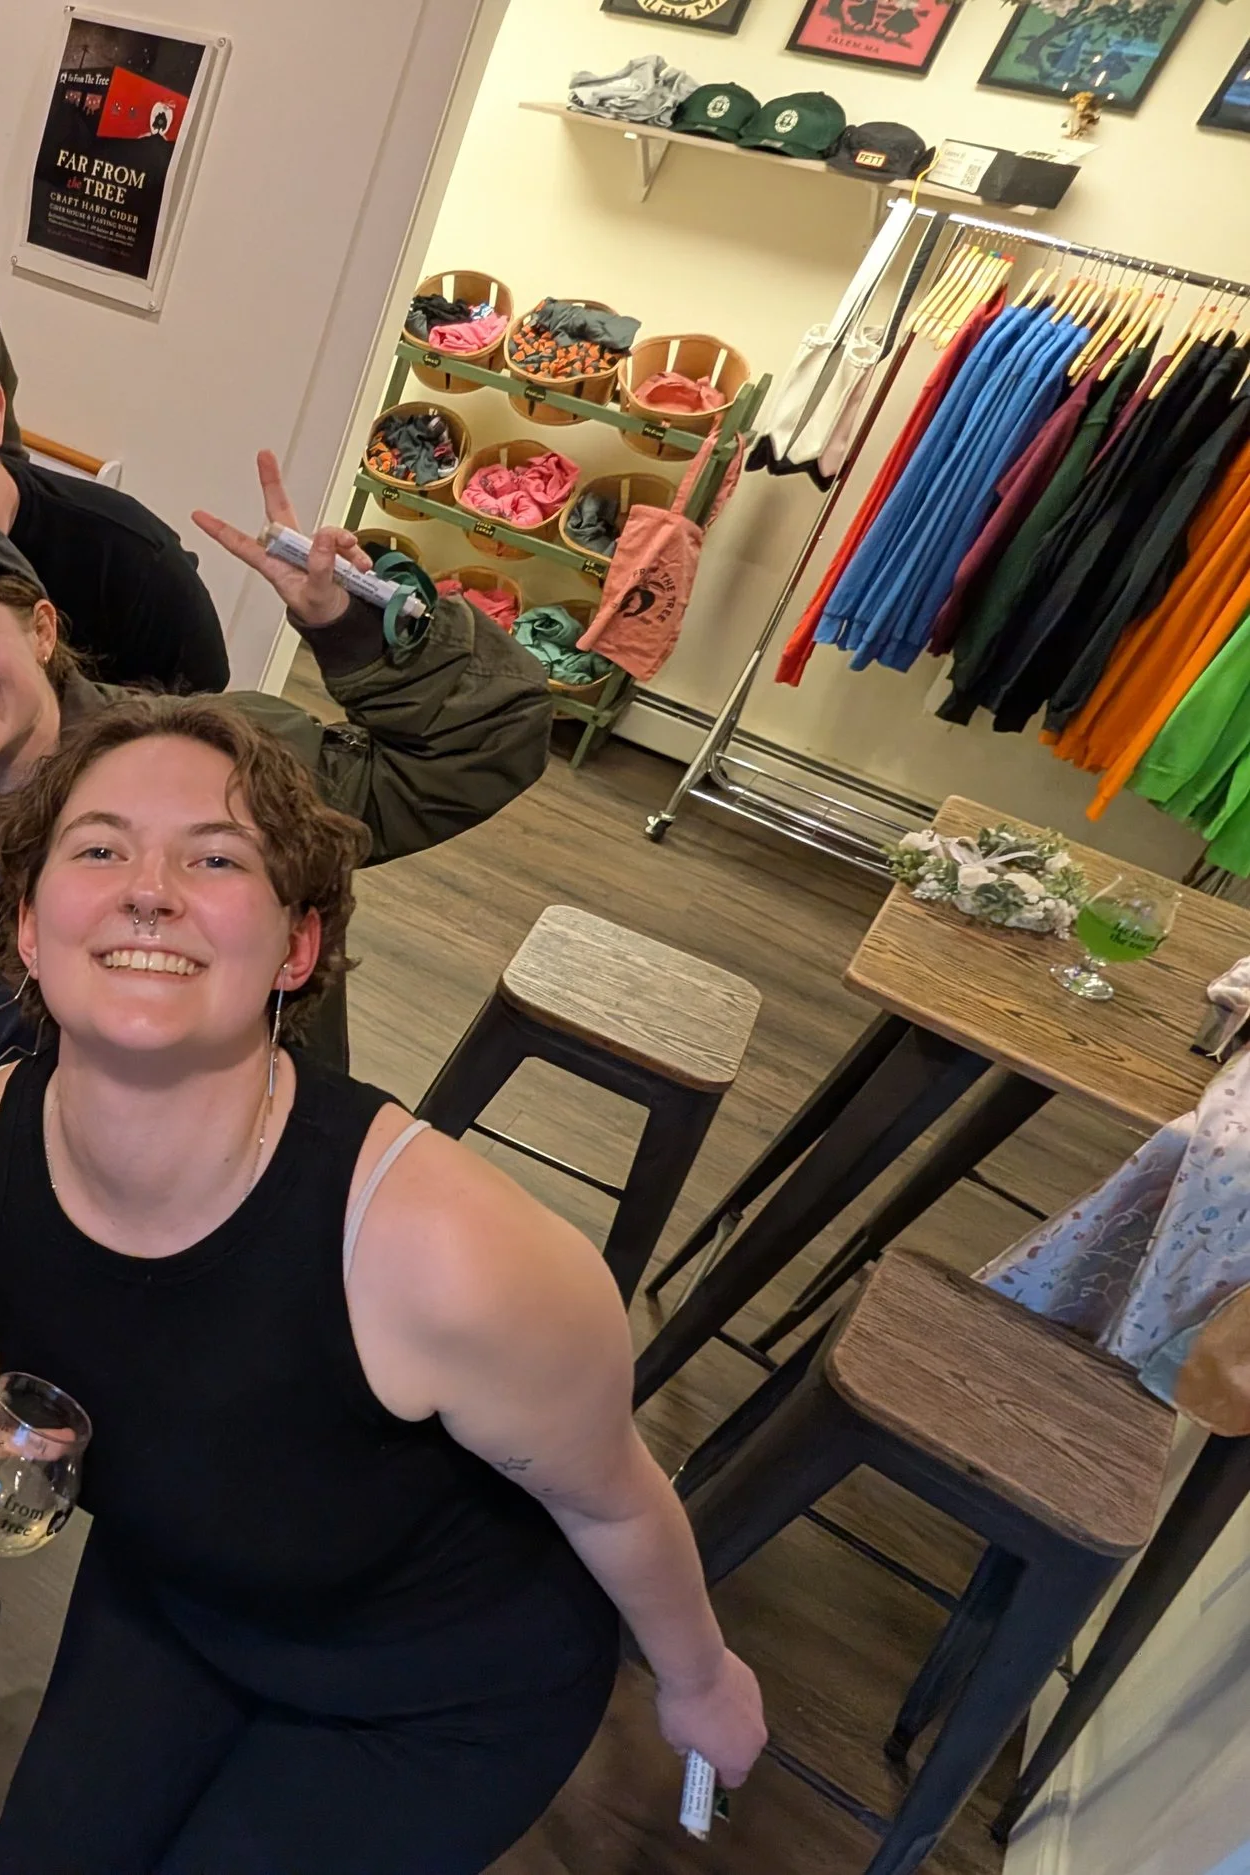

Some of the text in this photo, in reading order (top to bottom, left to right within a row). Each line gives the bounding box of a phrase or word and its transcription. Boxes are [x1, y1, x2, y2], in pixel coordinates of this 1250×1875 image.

[864, 43, 880, 54] MA
[85, 74, 95, 85] The
[95, 73, 110, 86] Tree
[56, 149, 146, 189] FAR FROM
[858, 152, 885, 166] FFTT
[66, 175, 128, 205] the TREE
[50, 192, 139, 225] CRAFT HARD CIDER
[66, 208, 86, 220] HOUSE
[91, 215, 117, 229] TASTING
[118, 224, 138, 234] ROOM
[660, 572, 676, 592] THE
[657, 597, 677, 624] TREE
[3, 1493, 45, 1521] from
[0, 1518, 32, 1537] tree
